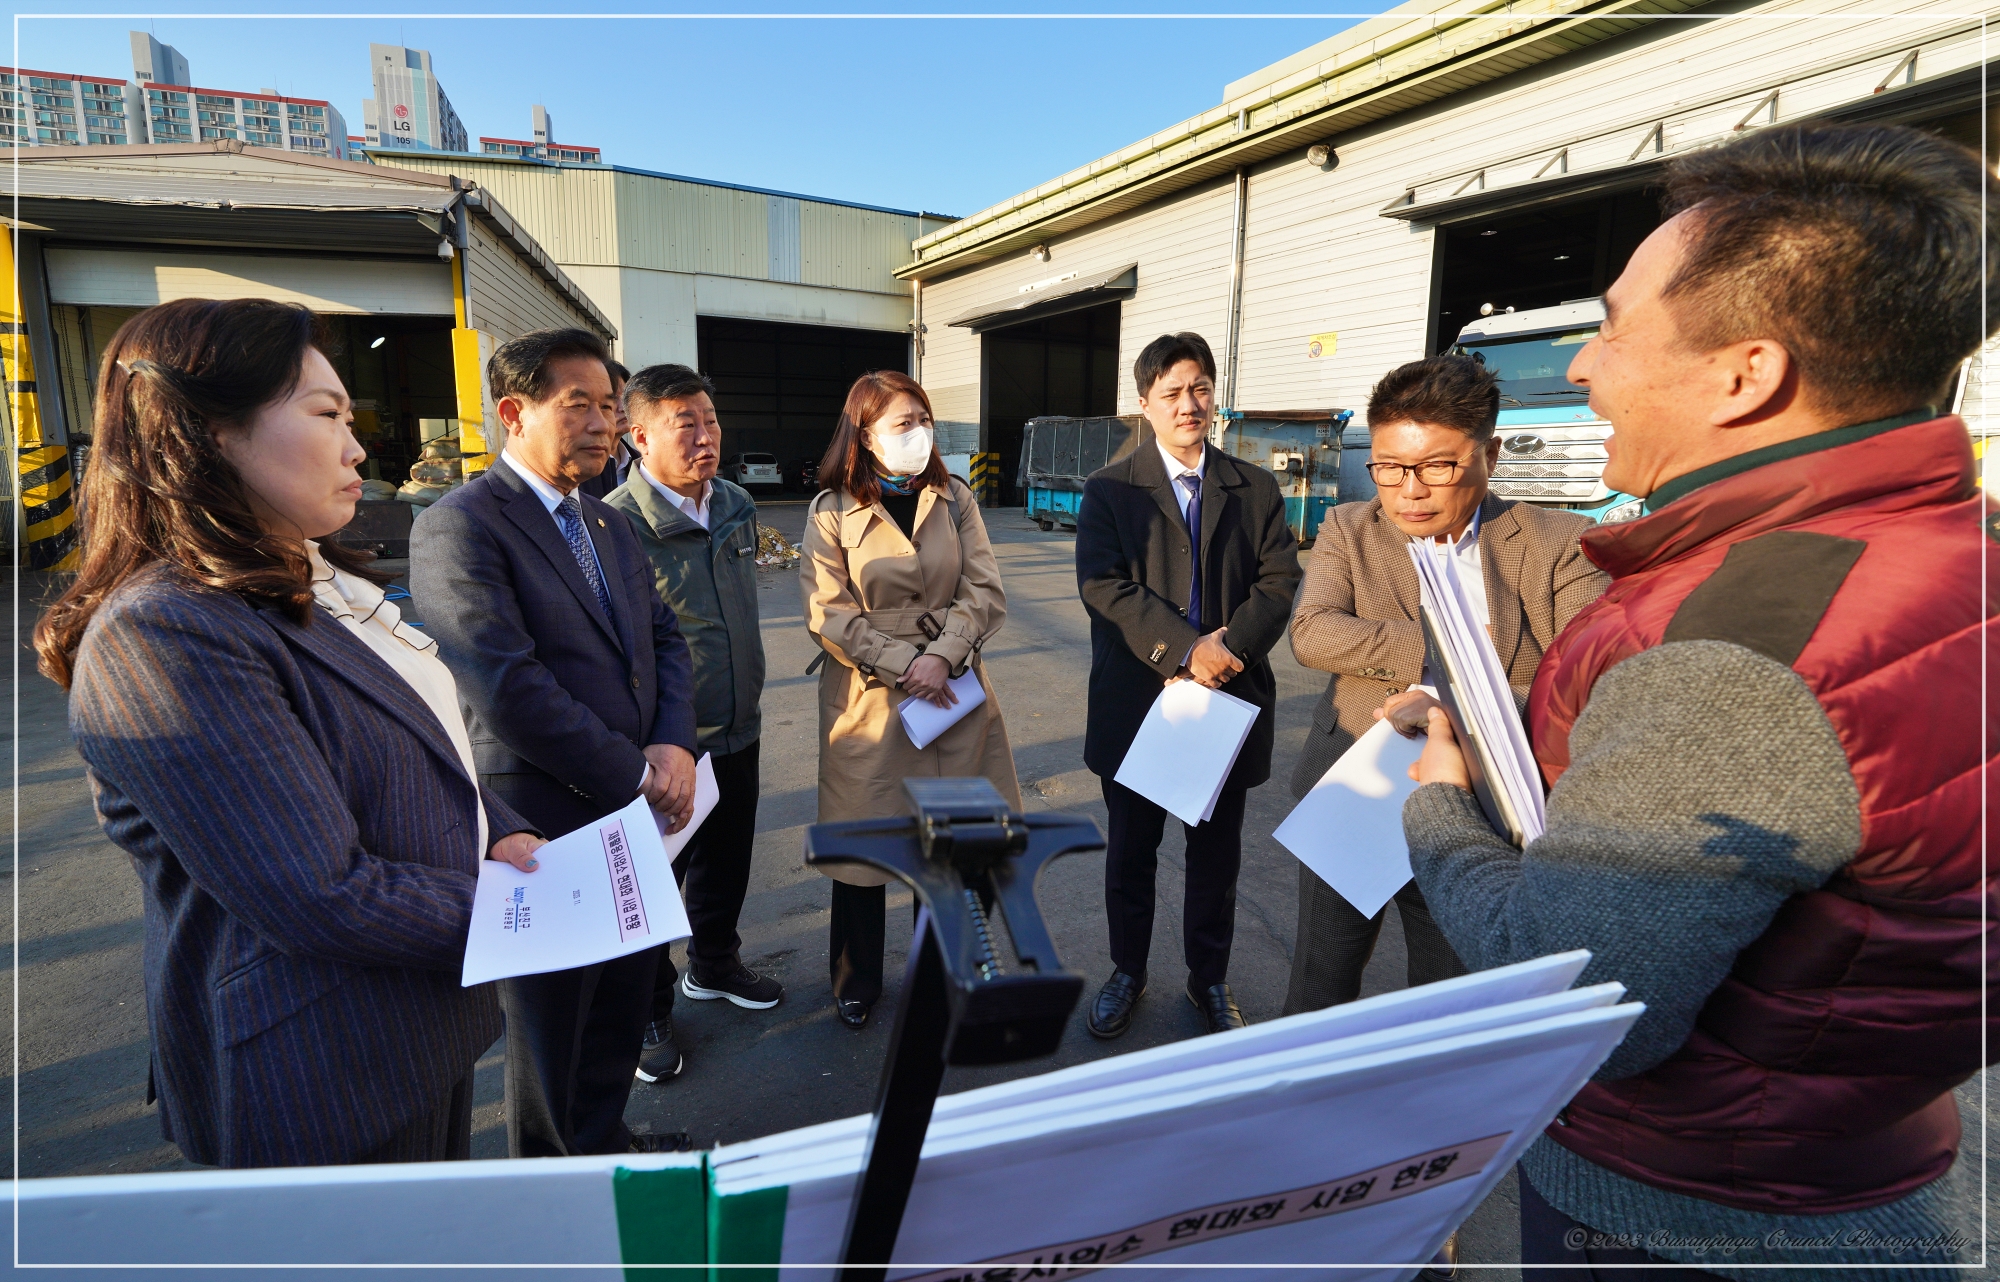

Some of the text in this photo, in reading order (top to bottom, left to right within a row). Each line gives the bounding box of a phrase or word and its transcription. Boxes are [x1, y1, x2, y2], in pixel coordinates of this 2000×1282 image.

[394, 120, 410, 131] LG
[396, 136, 411, 145] 105
[607, 829, 641, 931] 재활용사업소 현대화 사업 현황
[518, 906, 531, 929] 부산진구
[1167, 1198, 1287, 1242] 현대화
[1298, 1175, 1378, 1213] 사업
[1389, 1151, 1460, 1192] 현황
